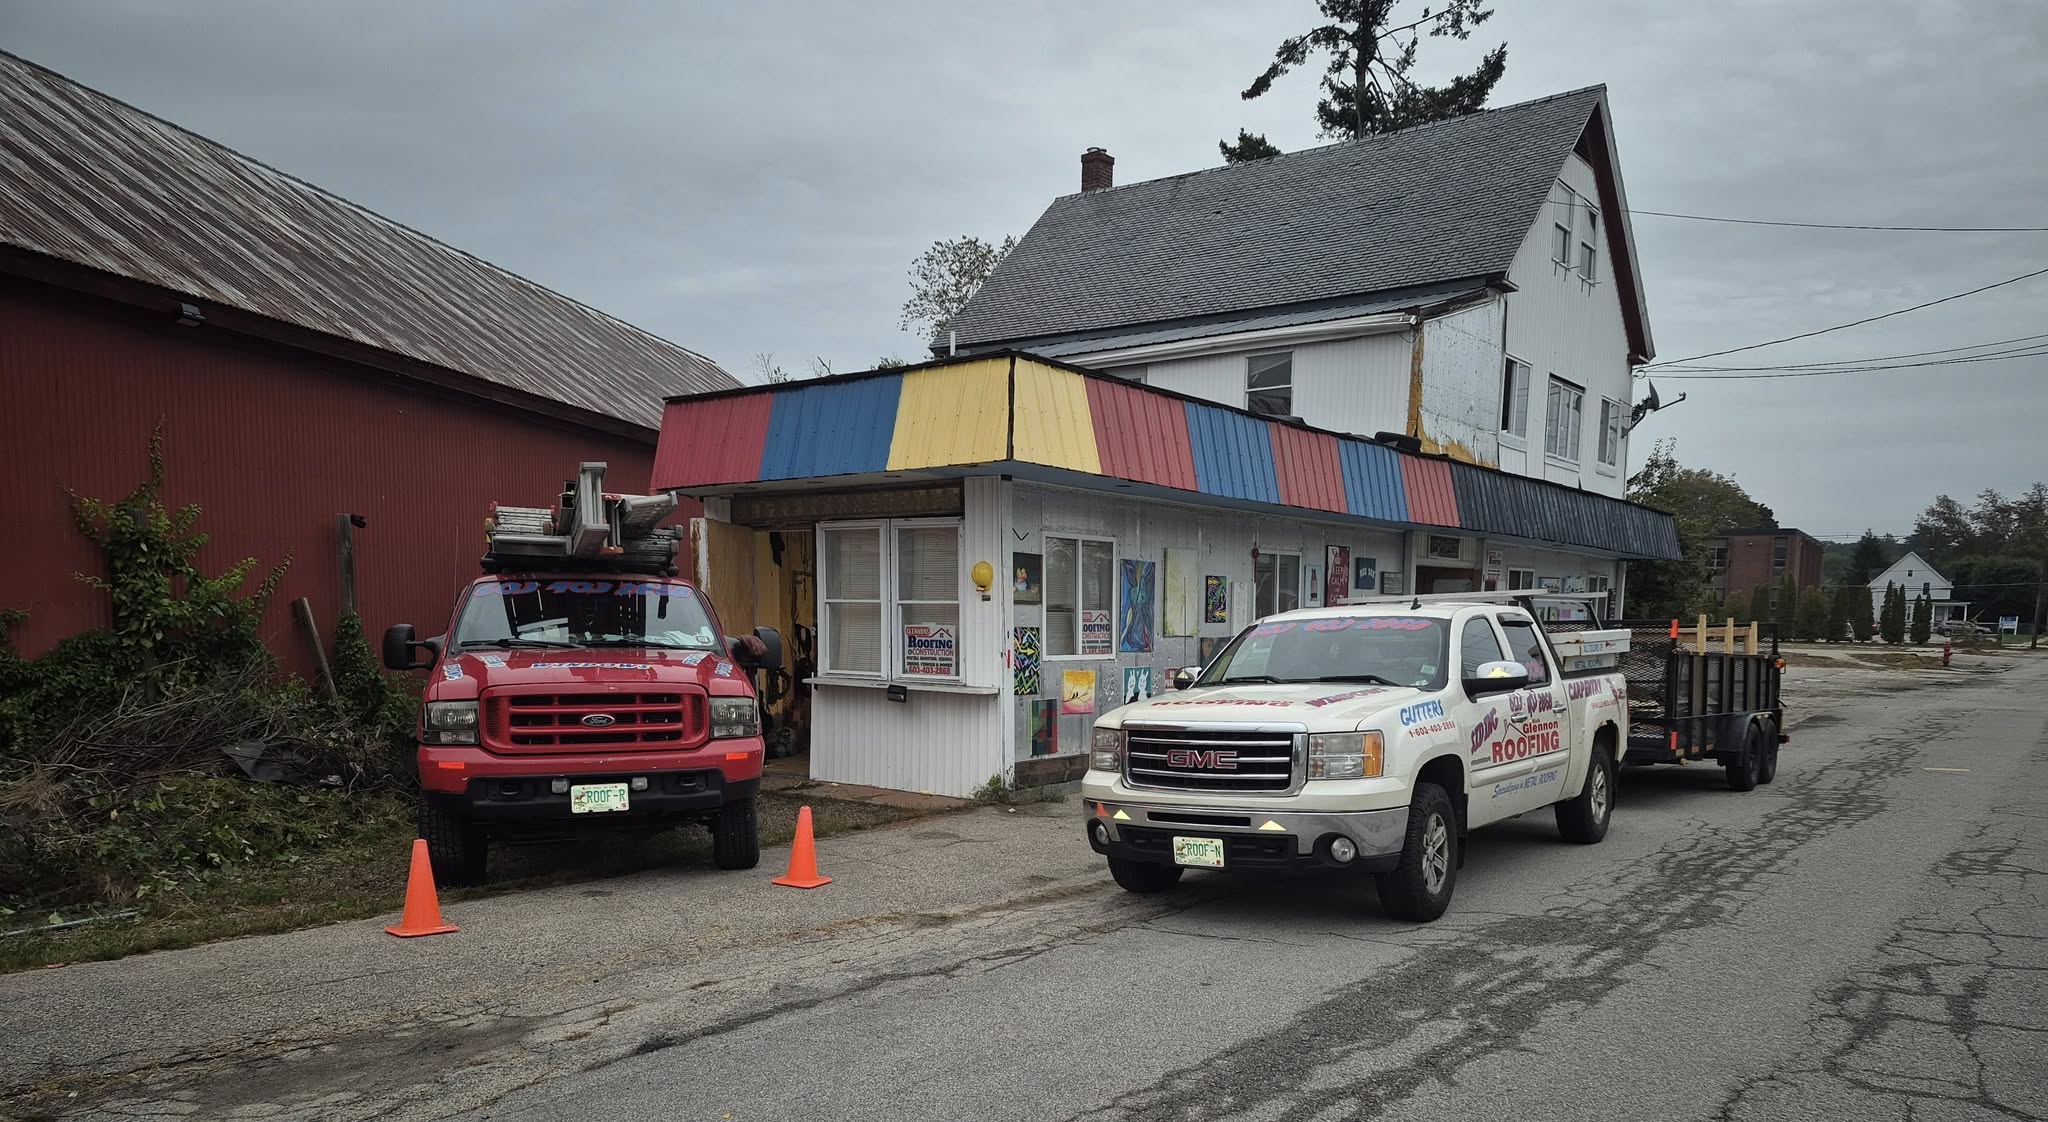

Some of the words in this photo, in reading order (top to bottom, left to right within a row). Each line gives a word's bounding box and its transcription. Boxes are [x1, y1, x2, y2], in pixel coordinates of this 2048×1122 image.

[1082, 623, 1110, 633] OOFING
[908, 636, 953, 649] ROOFING
[909, 666, 951, 675] 603-403-2868
[589, 716, 608, 725] Ford
[1400, 699, 1444, 727] GUTTERS
[1522, 720, 1559, 735] Glennon
[1492, 730, 1560, 764] ROOFING
[1167, 749, 1238, 769] GMC
[585, 788, 626, 804] ROOF-R
[1186, 843, 1221, 858] ROOF-N
